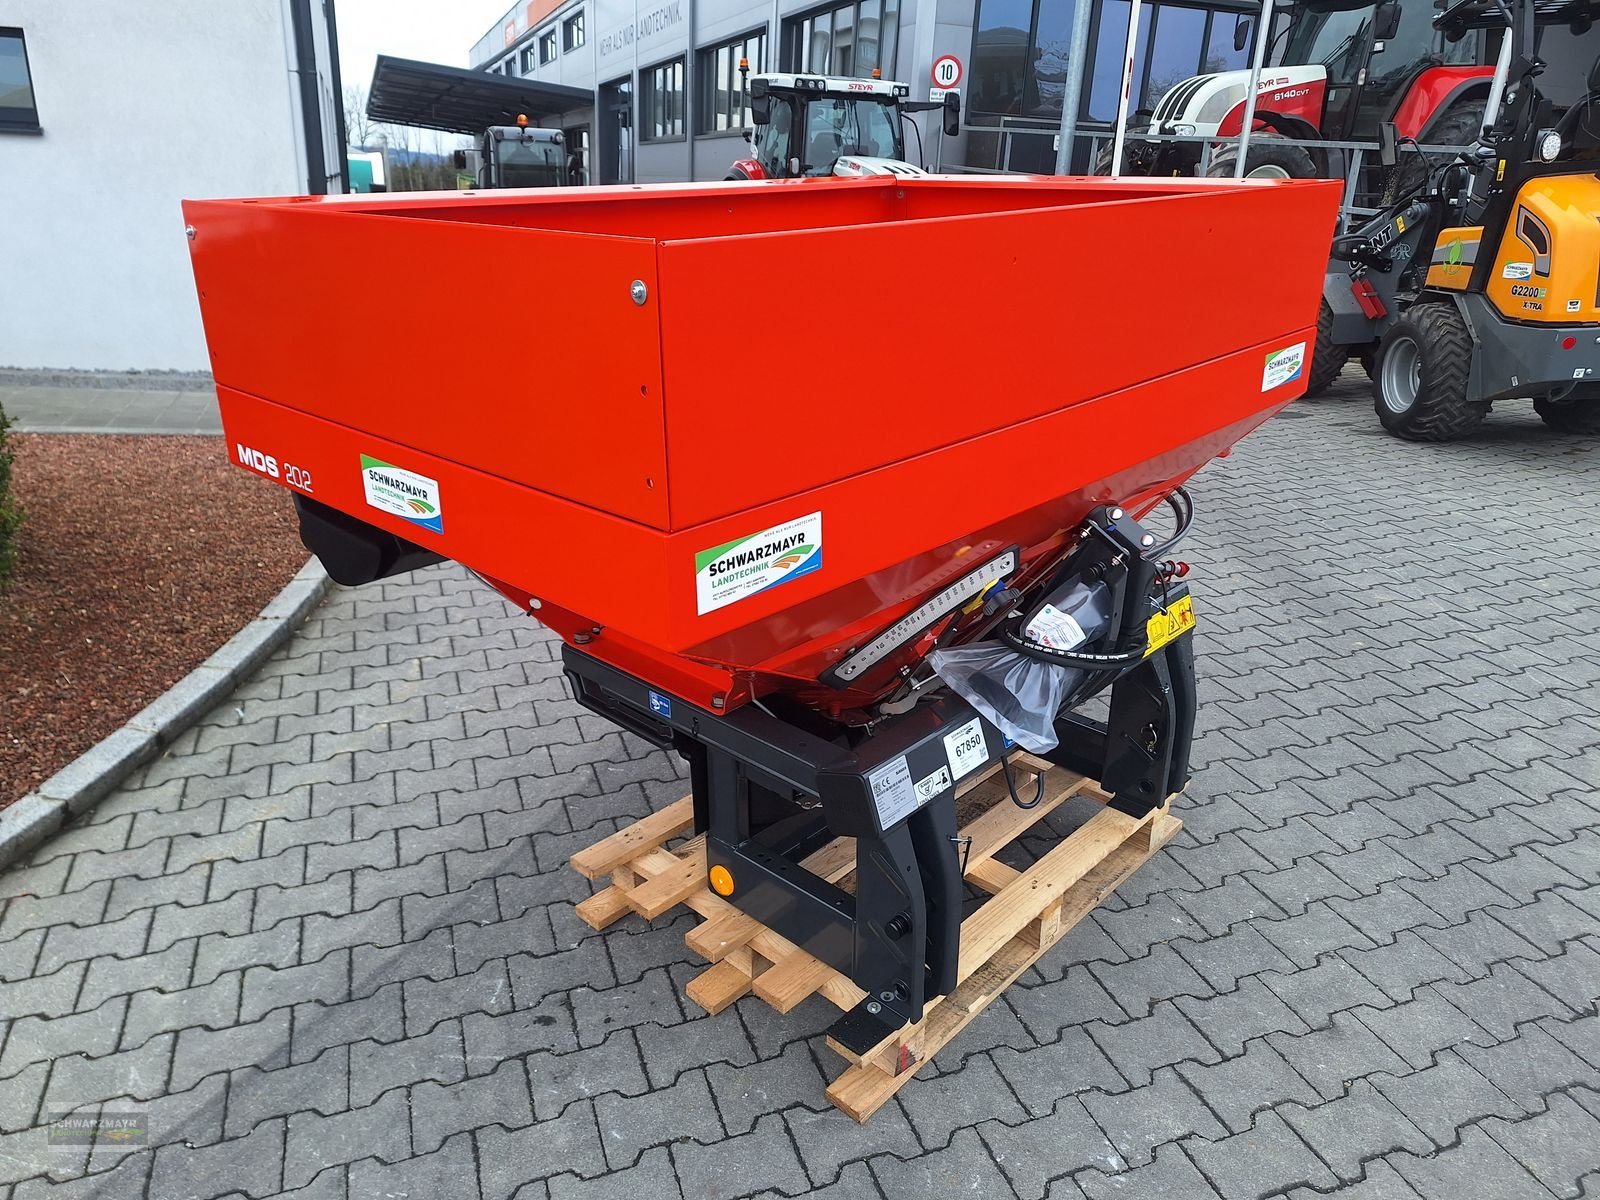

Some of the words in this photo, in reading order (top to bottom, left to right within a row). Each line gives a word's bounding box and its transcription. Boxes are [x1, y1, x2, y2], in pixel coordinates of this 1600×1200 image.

[940, 64, 953, 80] 10
[848, 83, 874, 91] STEYR
[236, 444, 279, 478] MDS
[284, 463, 314, 493] 20.2
[369, 470, 428, 501] SCHWARZMAYR
[372, 484, 405, 502] LANDTECHNIK
[709, 532, 805, 577] SCHWARZMAYR
[712, 561, 769, 589] LANDTECHNIK
[956, 734, 981, 757] 67850
